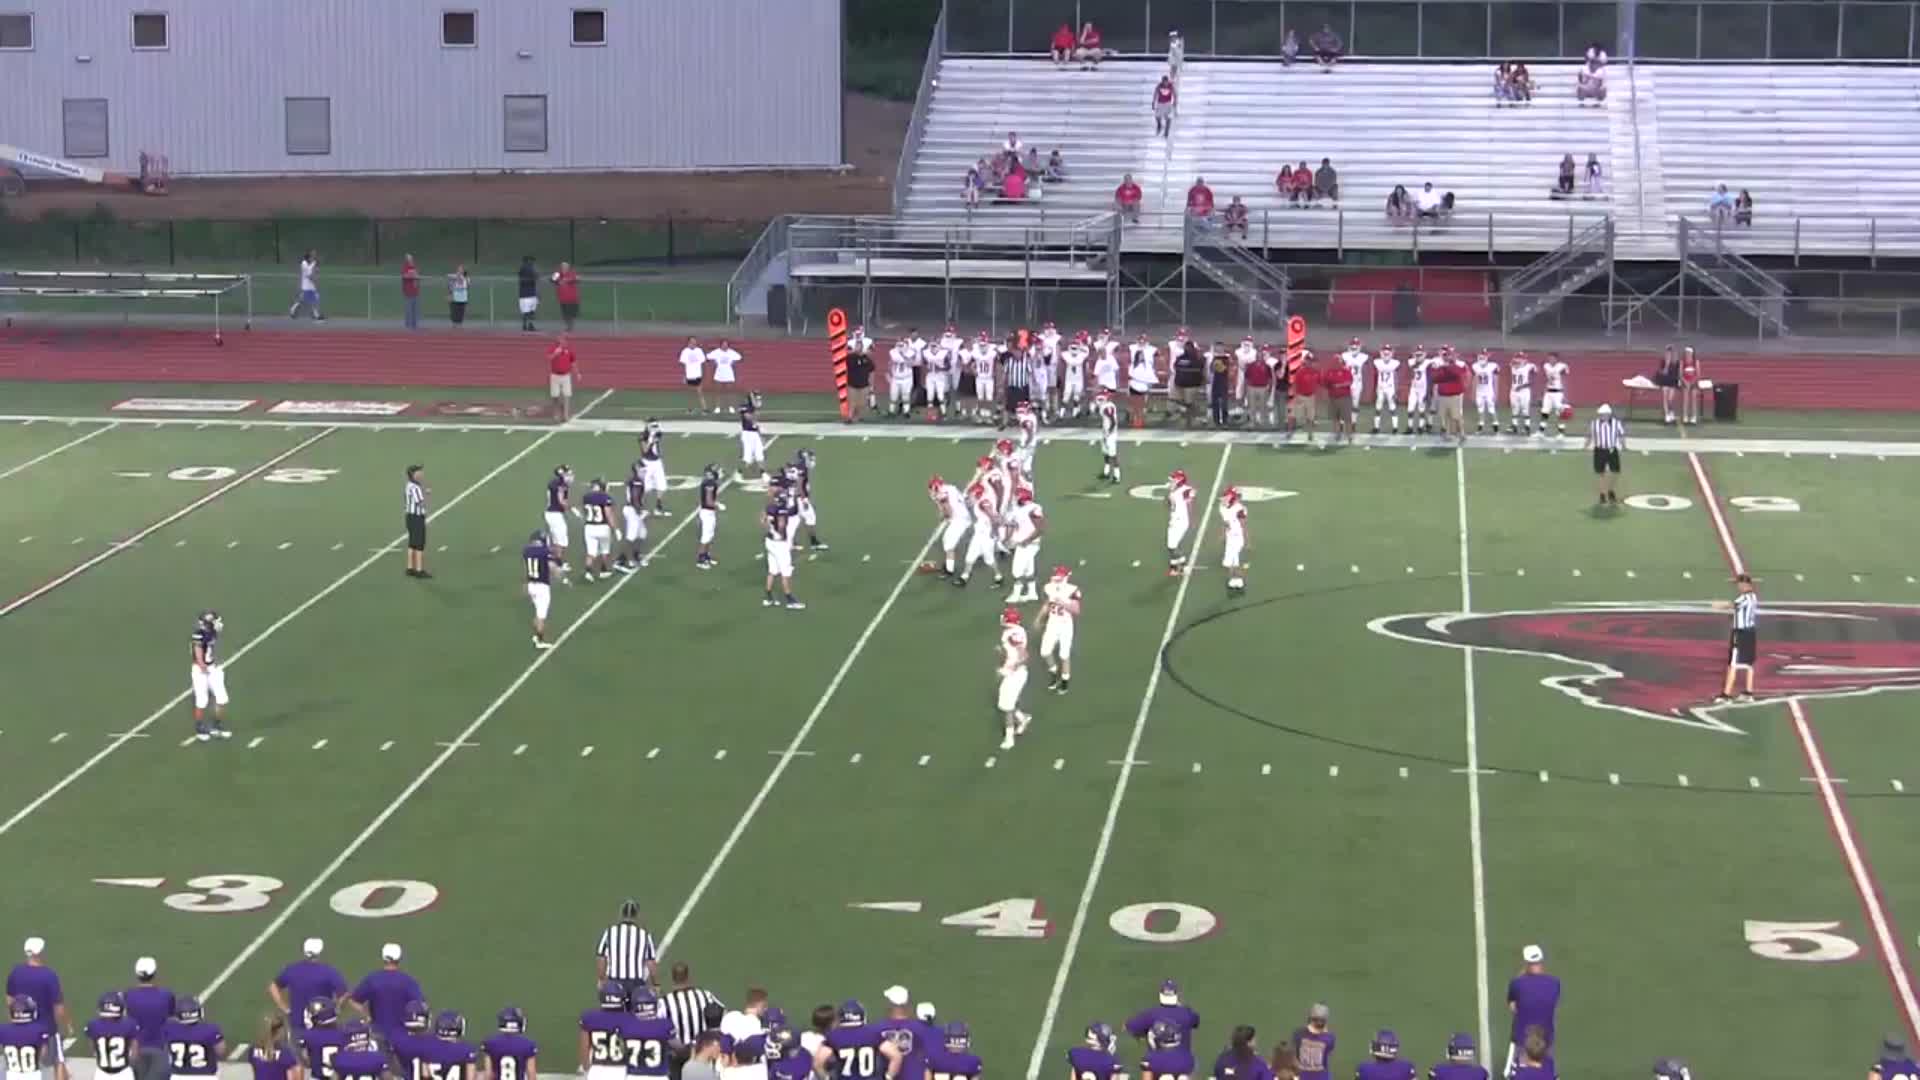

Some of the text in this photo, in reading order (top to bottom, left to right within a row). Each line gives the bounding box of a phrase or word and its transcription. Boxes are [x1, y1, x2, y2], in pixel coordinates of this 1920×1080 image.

[528, 558, 539, 578] 11
[4, 1045, 36, 1073] 80
[97, 1036, 126, 1068] 12
[170, 1043, 208, 1068] 72
[591, 1031, 624, 1062] 56
[626, 1039, 662, 1068] 73
[839, 1046, 875, 1077] 70
